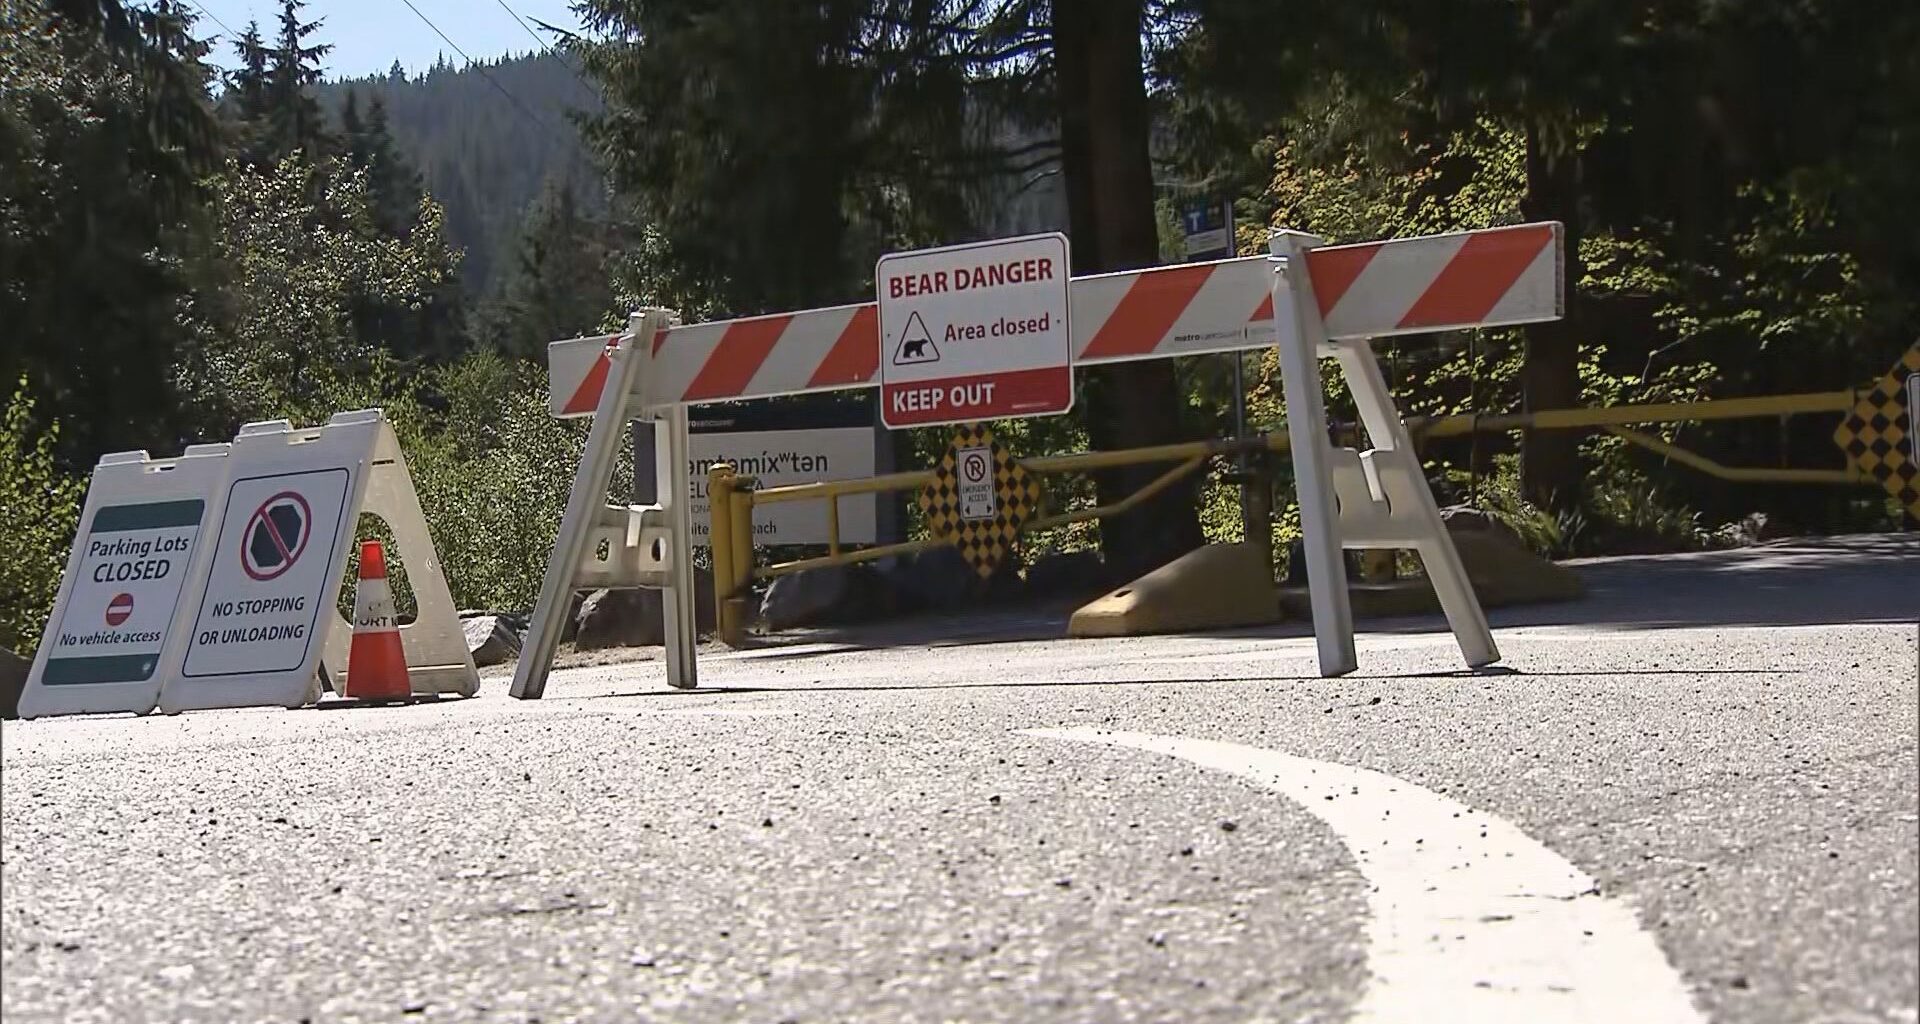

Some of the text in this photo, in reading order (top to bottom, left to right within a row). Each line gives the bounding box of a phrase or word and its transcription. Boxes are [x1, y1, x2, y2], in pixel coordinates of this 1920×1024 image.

[889, 258, 1053, 299] BEAR DANGER
[944, 311, 1050, 343] Area closed
[893, 382, 995, 413] KEEP OUT
[89, 536, 189, 558] Parking Lots
[93, 559, 170, 583] CLOSED
[212, 596, 305, 617] NO STOPPING
[59, 631, 161, 646] No vehicle access
[199, 624, 305, 646] OR UNLOADING
